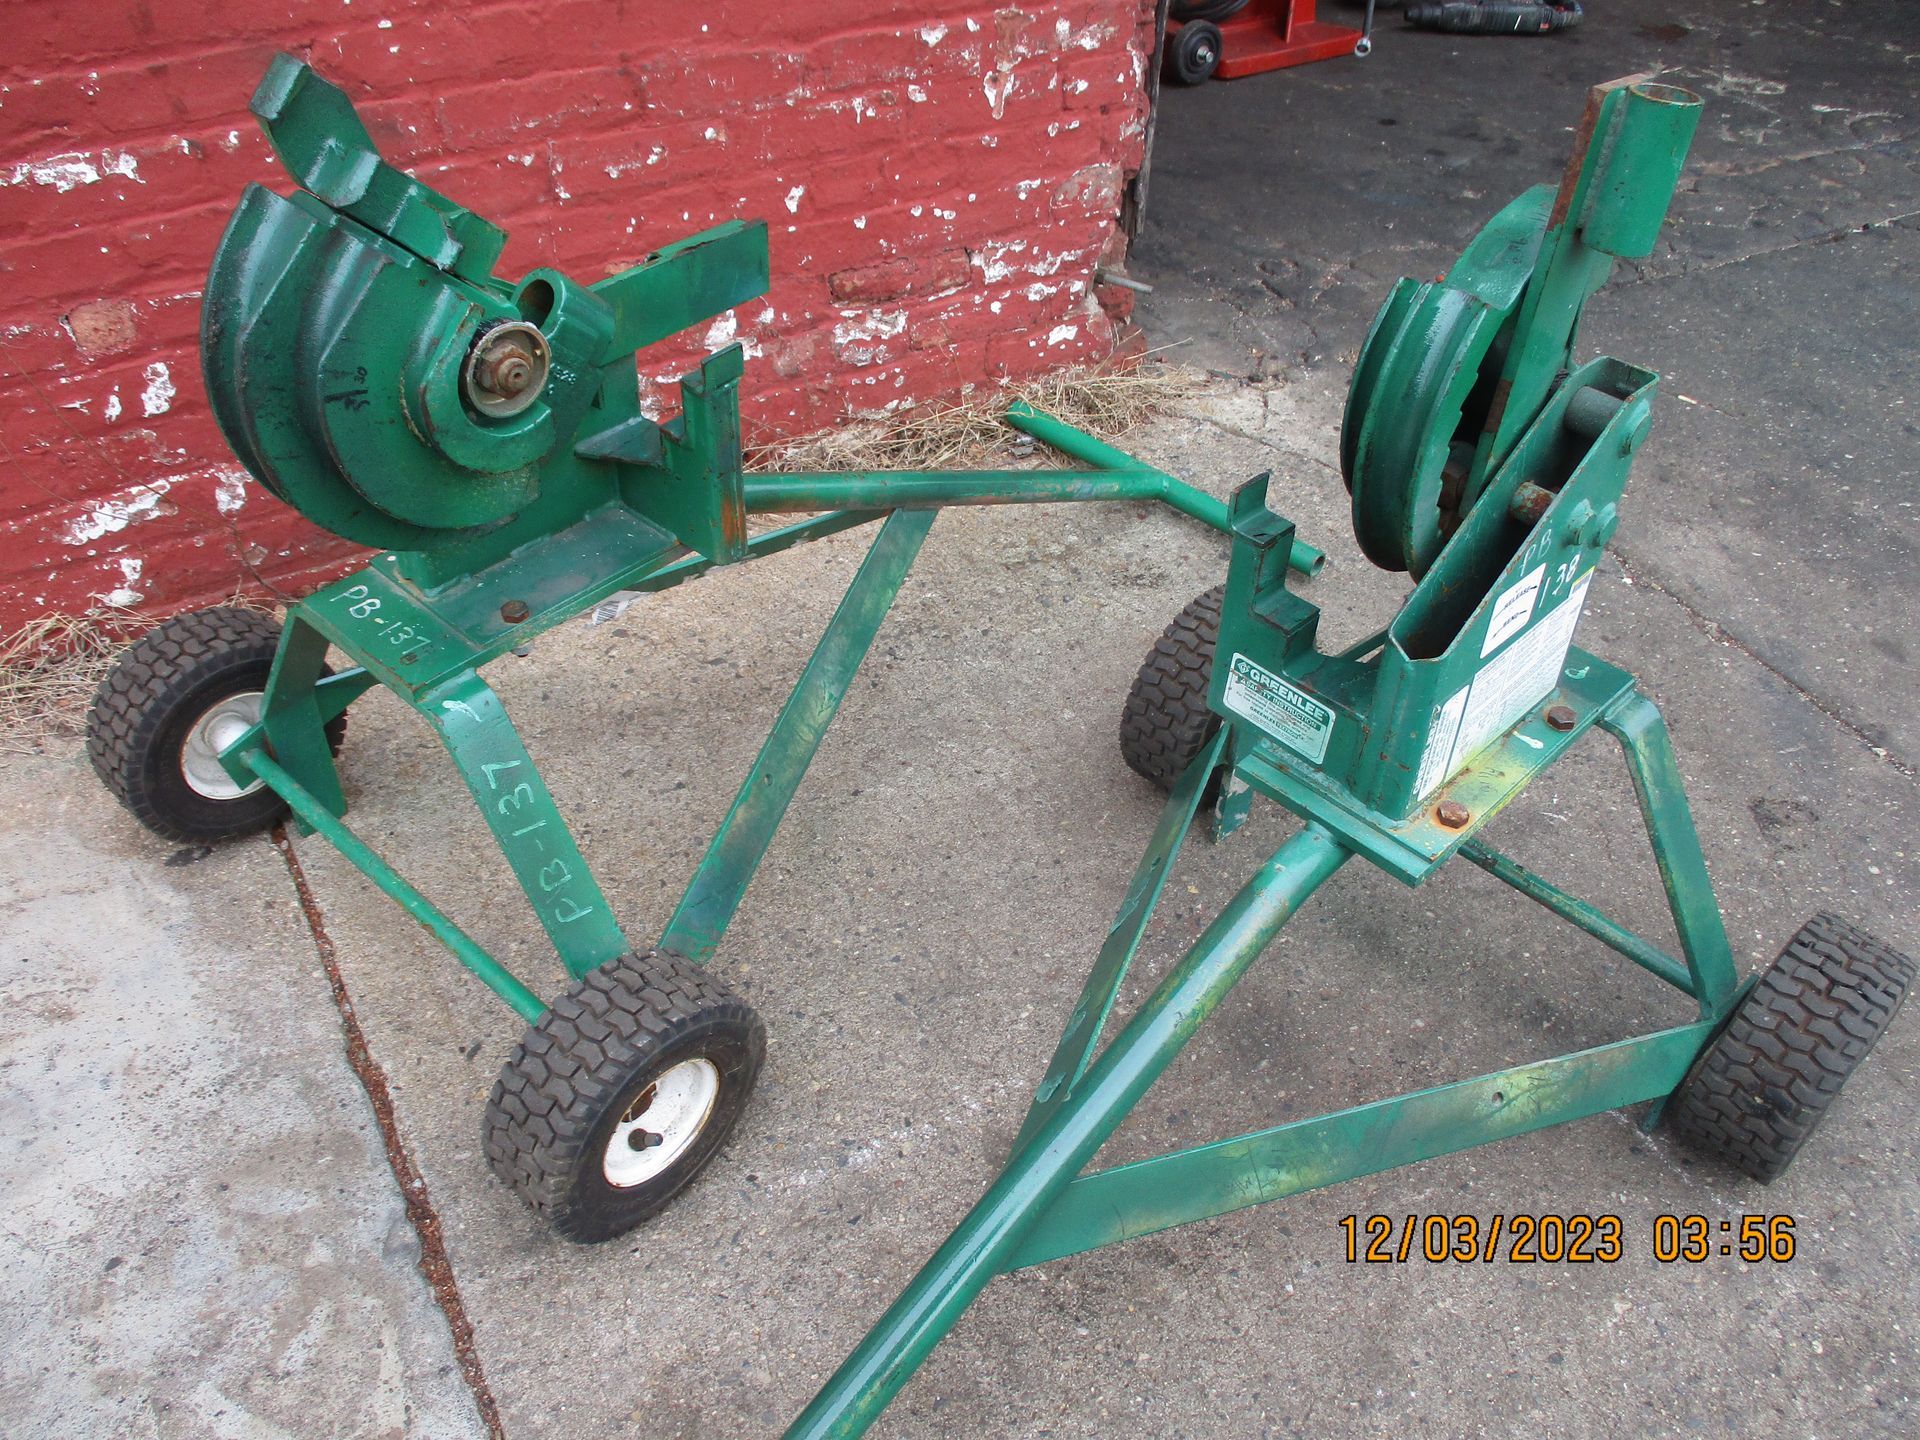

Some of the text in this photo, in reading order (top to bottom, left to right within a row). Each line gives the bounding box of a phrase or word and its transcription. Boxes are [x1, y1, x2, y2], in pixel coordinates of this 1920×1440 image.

[1519, 528, 1552, 577] PB
[1539, 553, 1580, 609] 138
[329, 584, 432, 655] PB-137
[1246, 680, 1271, 700] SAFTY
[1250, 669, 1324, 721] GREENLEE
[480, 759, 593, 923] PB-137
